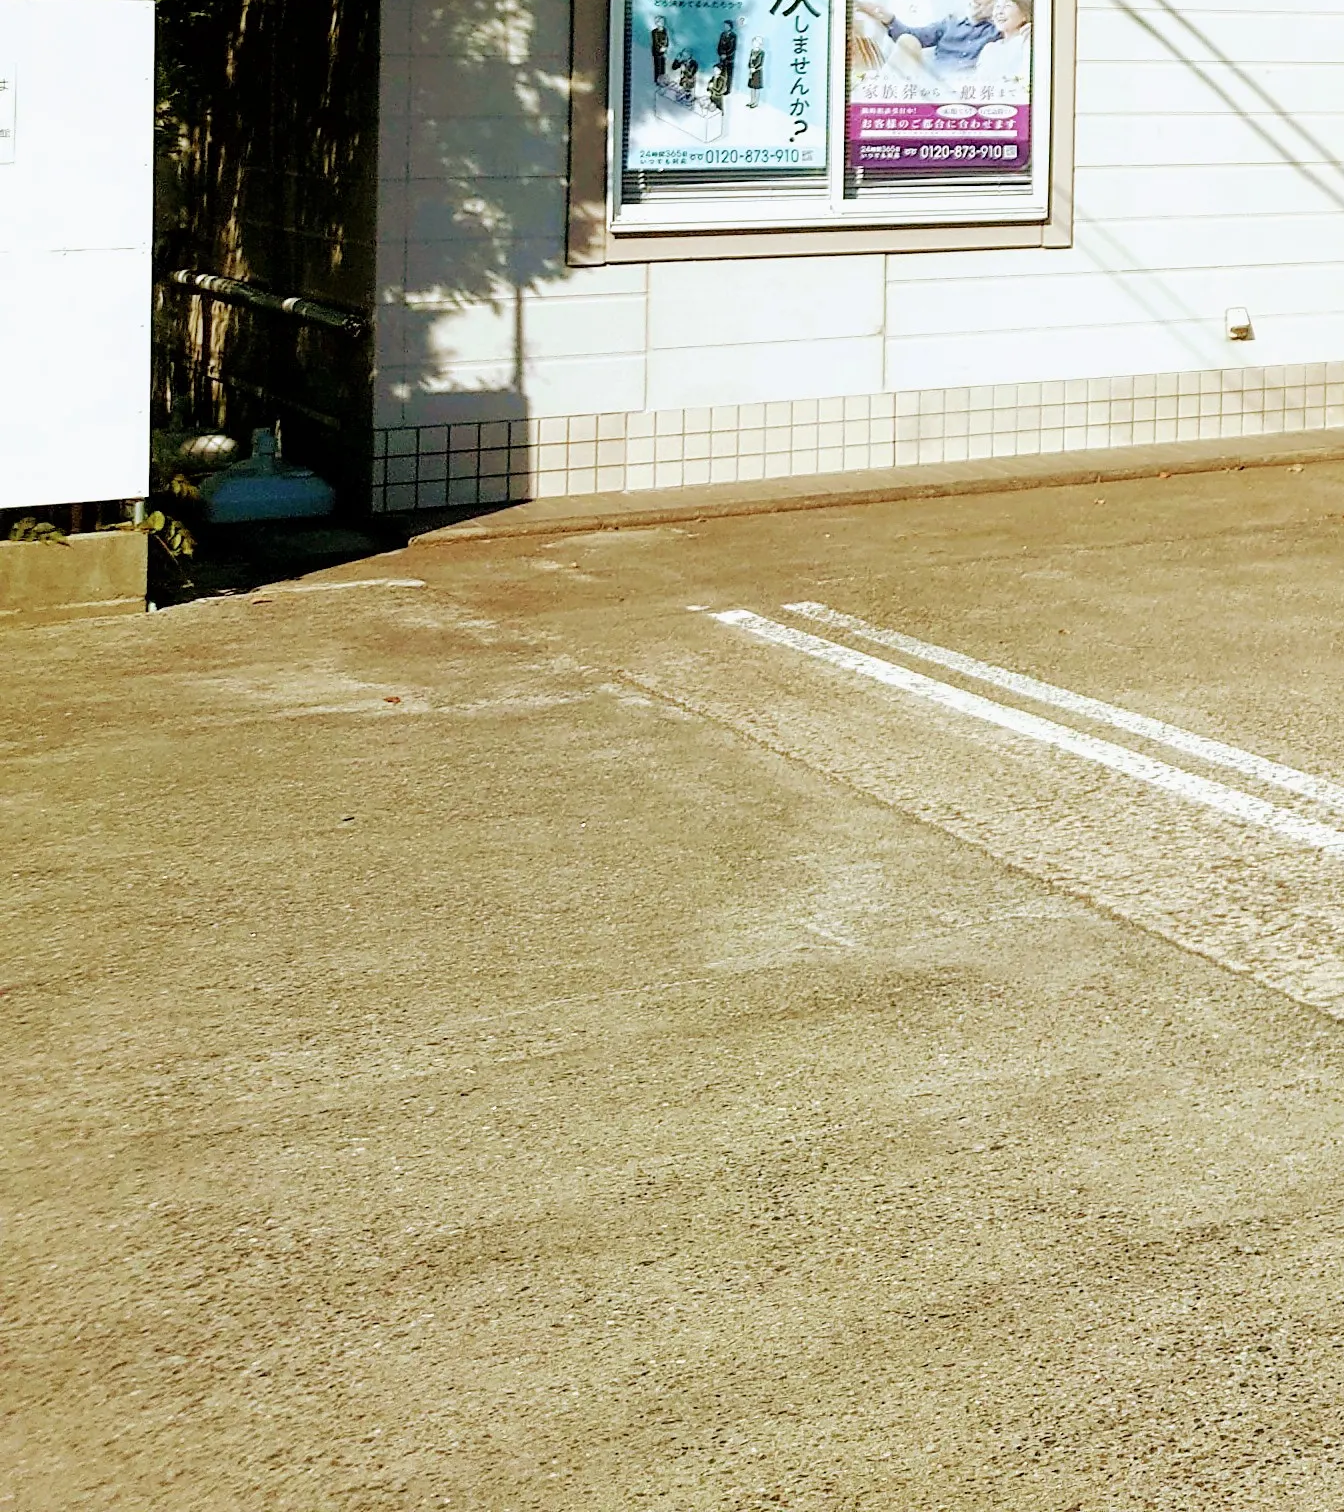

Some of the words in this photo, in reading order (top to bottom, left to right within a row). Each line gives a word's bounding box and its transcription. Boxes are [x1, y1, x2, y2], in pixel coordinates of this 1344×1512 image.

[861, 118, 1016, 130] お客様のご都合に合わせます
[705, 149, 799, 163] 0120-873-910
[919, 144, 1002, 159] 0120-873-910
